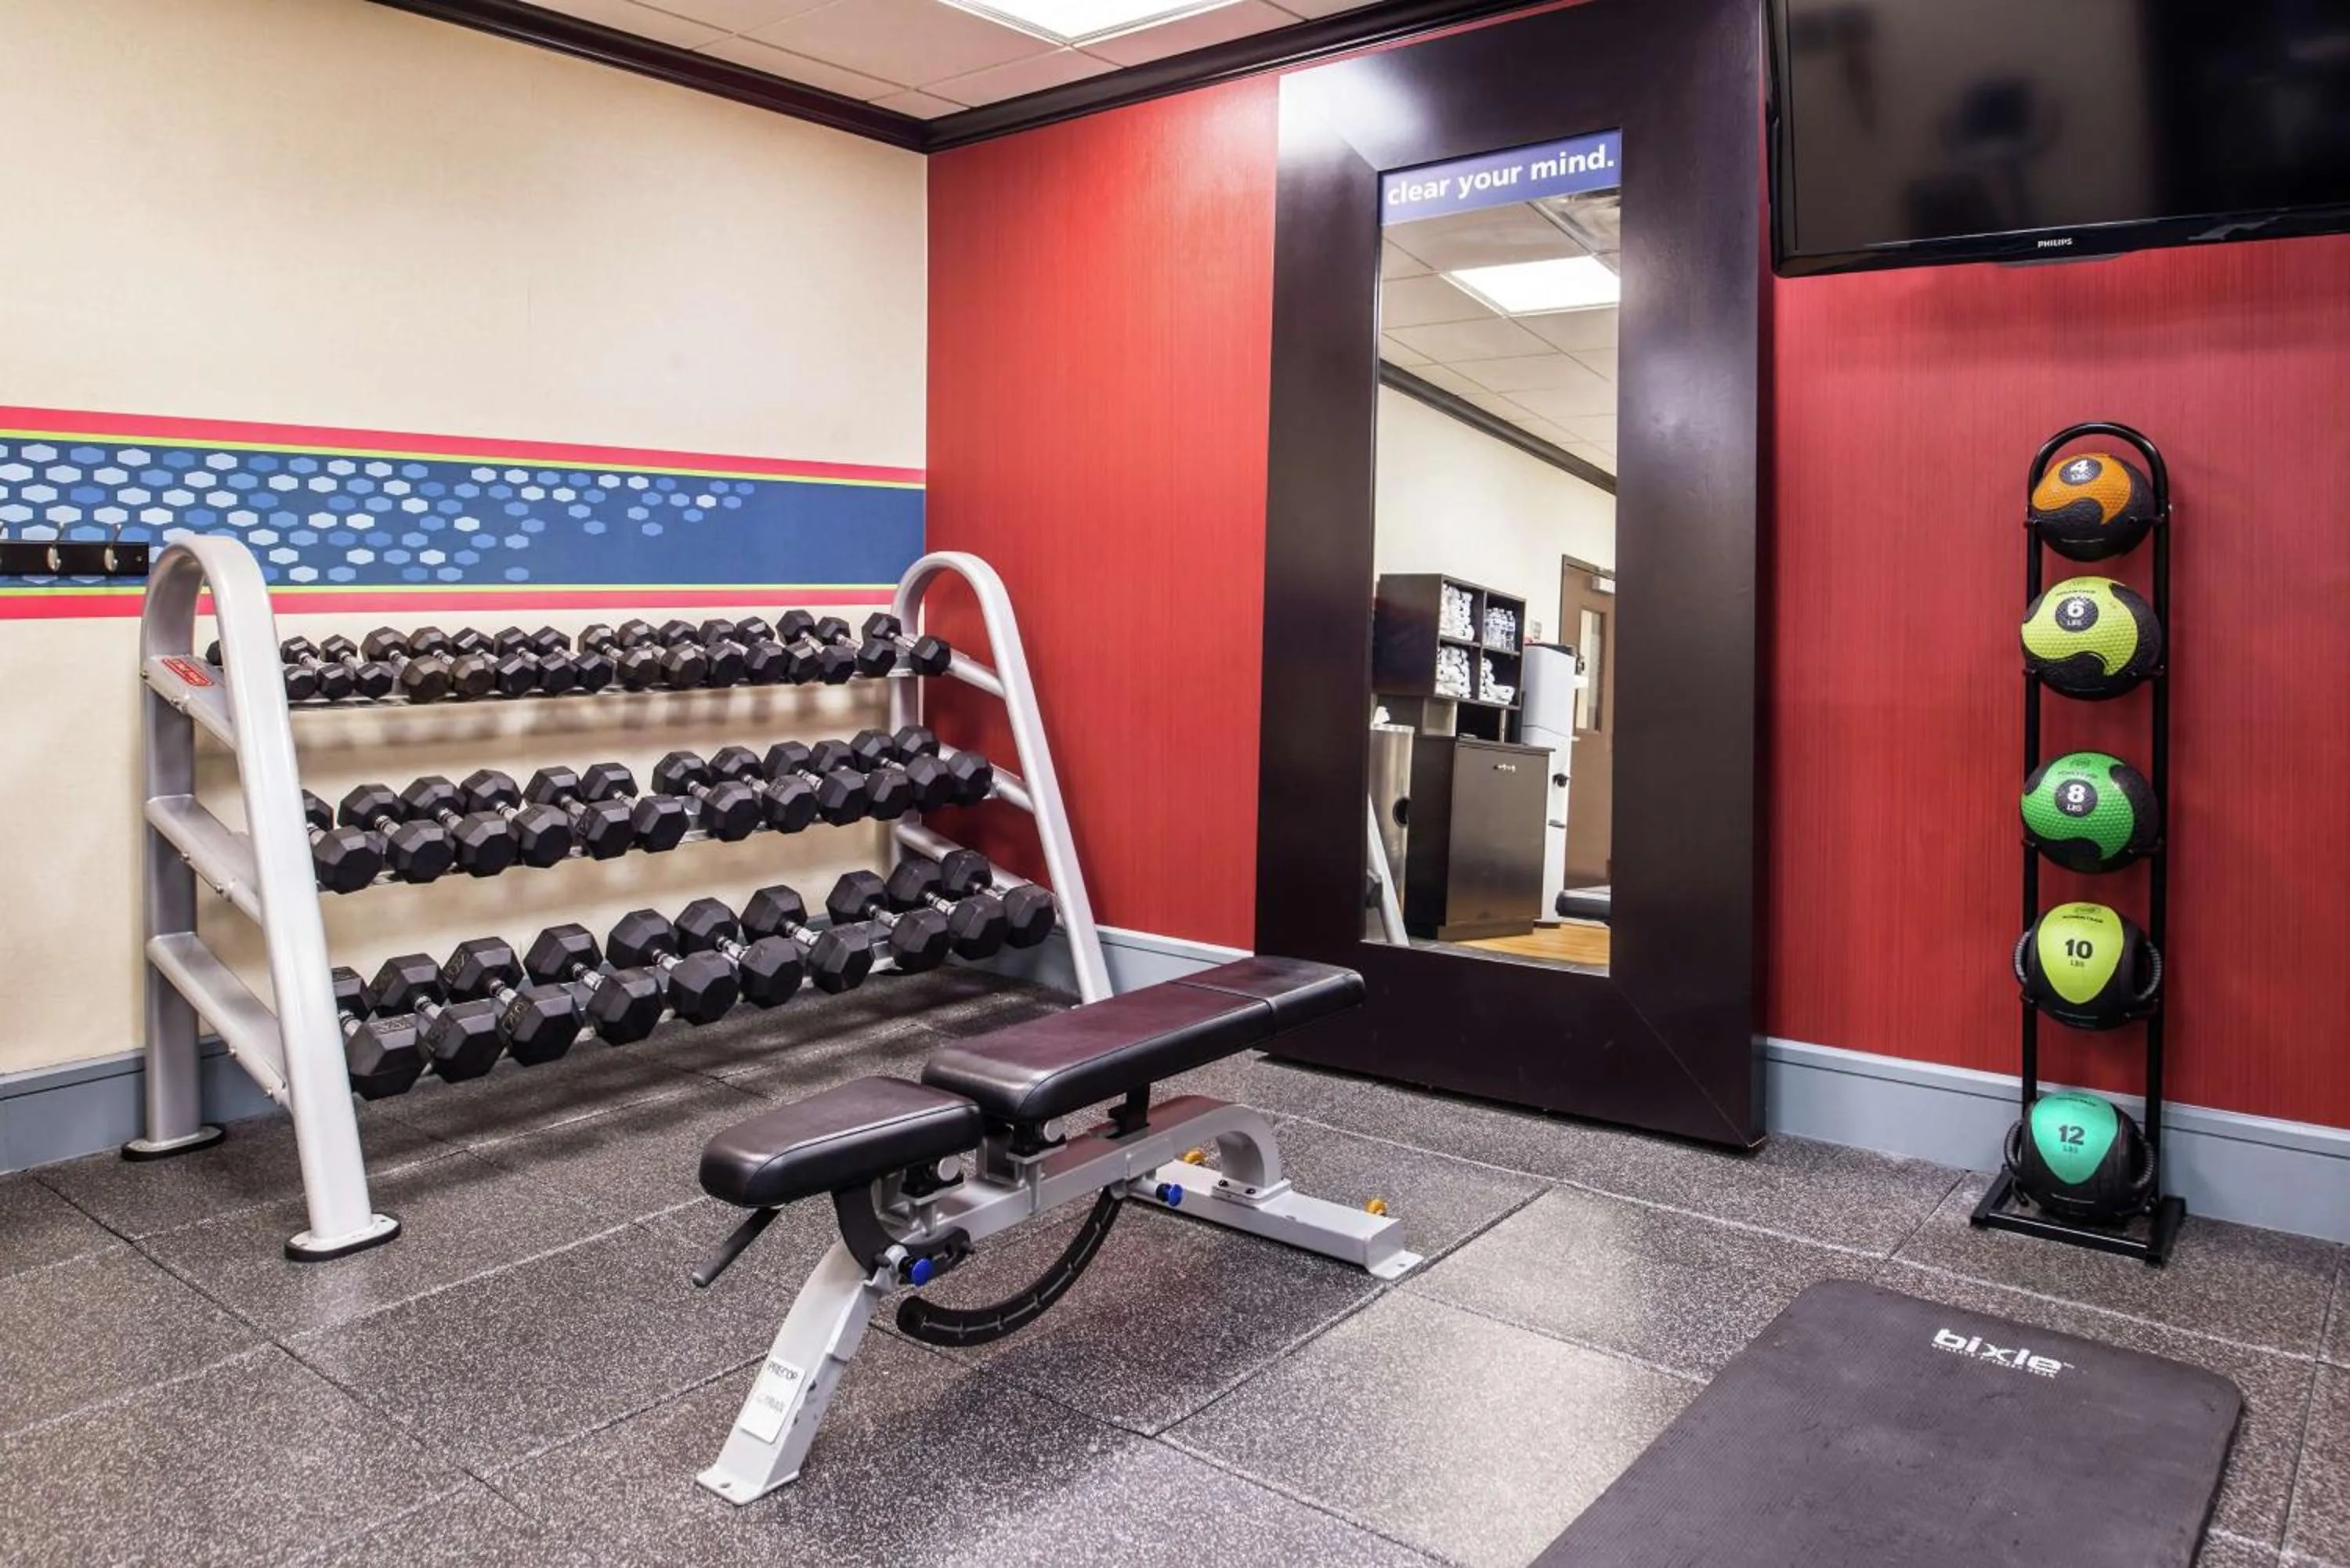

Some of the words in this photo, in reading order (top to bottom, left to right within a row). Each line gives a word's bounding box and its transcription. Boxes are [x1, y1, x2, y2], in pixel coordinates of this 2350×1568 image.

[1386, 177, 1451, 205] clear
[1458, 164, 1523, 199] your
[1530, 143, 1614, 181] mind.
[2037, 237, 2073, 248] PHILIPS
[2070, 459, 2089, 473] 4
[2067, 600, 2085, 618] 6
[2067, 784, 2086, 803] 8
[2065, 938, 2094, 959] 10
[2058, 1125, 2085, 1146] 12
[1933, 1328, 2062, 1374] bixle
